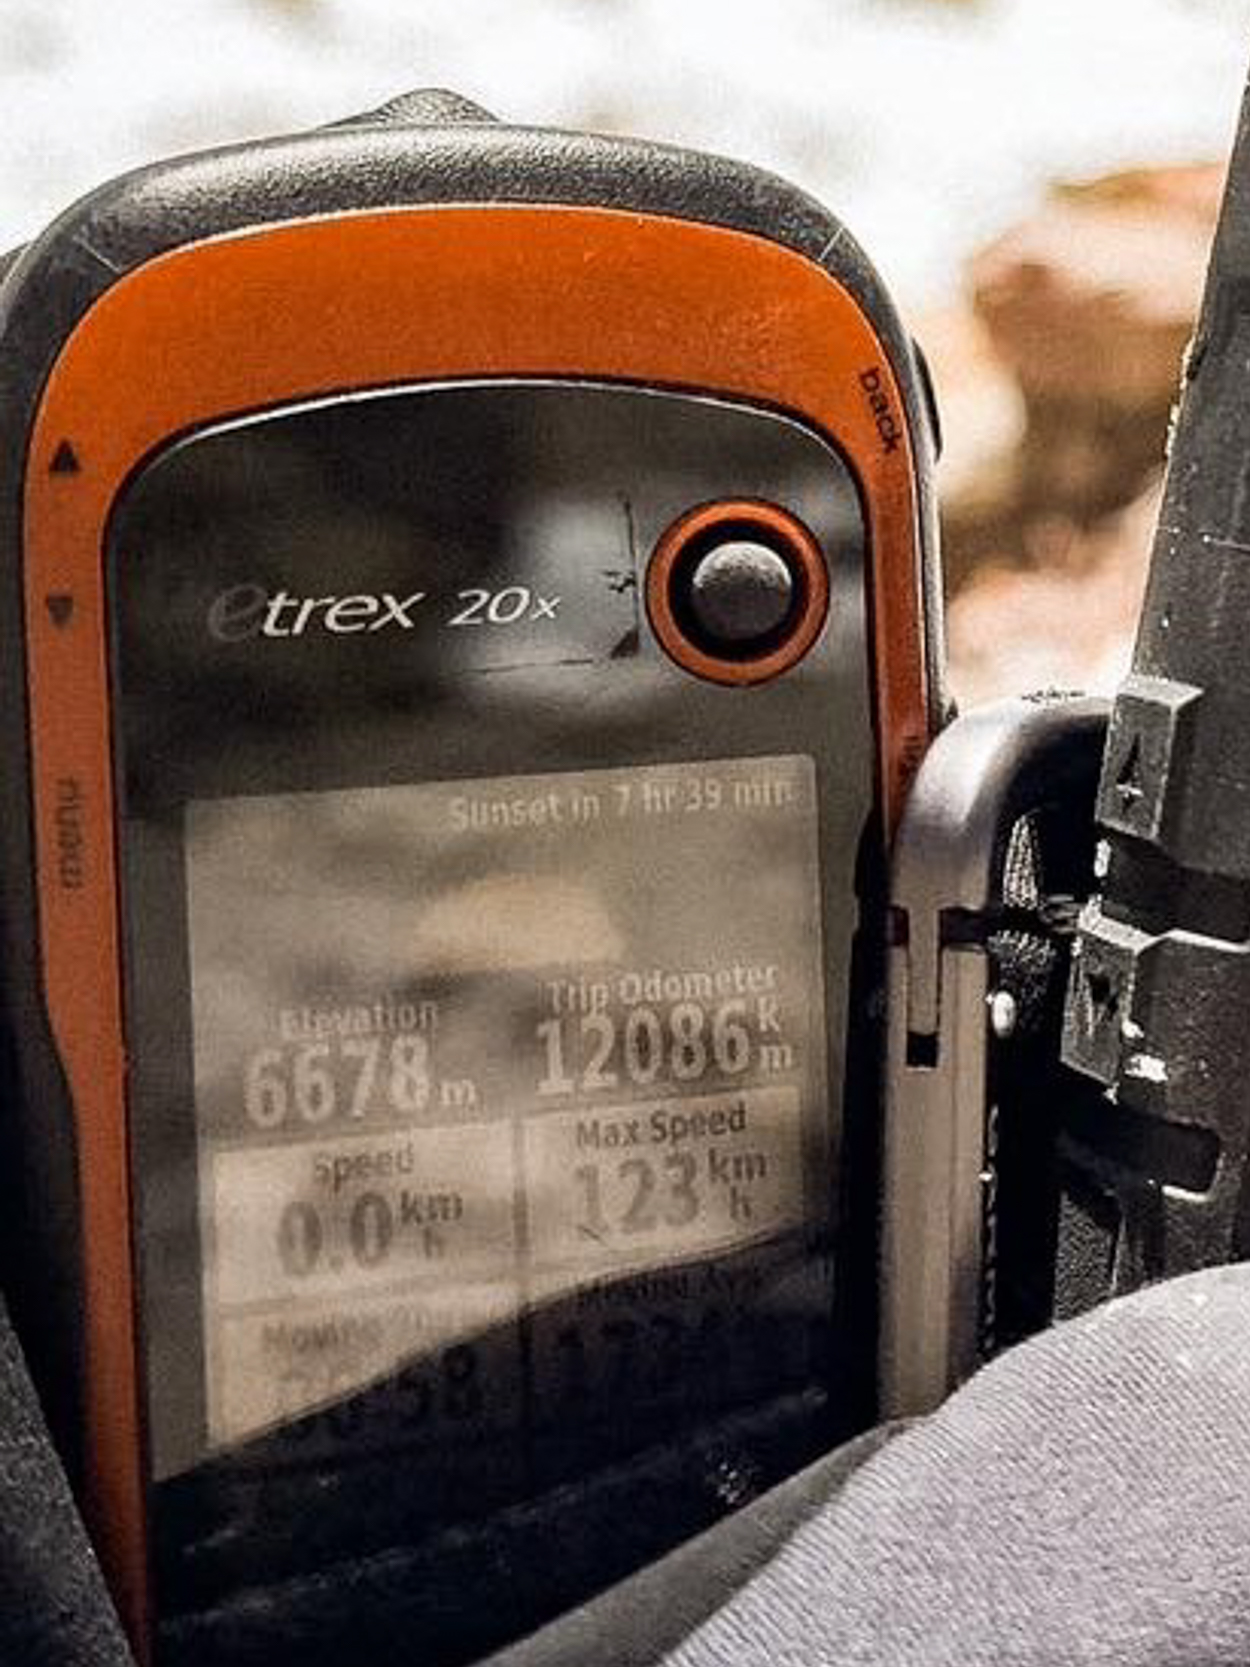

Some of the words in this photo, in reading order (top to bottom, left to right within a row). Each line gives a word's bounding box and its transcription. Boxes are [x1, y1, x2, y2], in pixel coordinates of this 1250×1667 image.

[860, 367, 902, 455] back
[450, 586, 561, 626] 20x
[450, 794, 562, 832] Sunset
[571, 795, 599, 821] in
[611, 784, 632, 816] 7
[643, 782, 676, 813] hr
[683, 779, 722, 811] 39
[734, 779, 794, 808] min
[280, 1001, 439, 1041] Elevation
[548, 977, 610, 1021] Trip
[619, 963, 777, 1005] Odometer
[537, 1000, 751, 1095] 12086
[245, 1034, 429, 1128] 6678
[441, 1077, 476, 1106] m
[577, 1119, 640, 1151] Max
[650, 1101, 746, 1147] Speed
[314, 1142, 414, 1195] Speed
[574, 1152, 698, 1234] 123
[278, 1191, 394, 1277] 0.0
